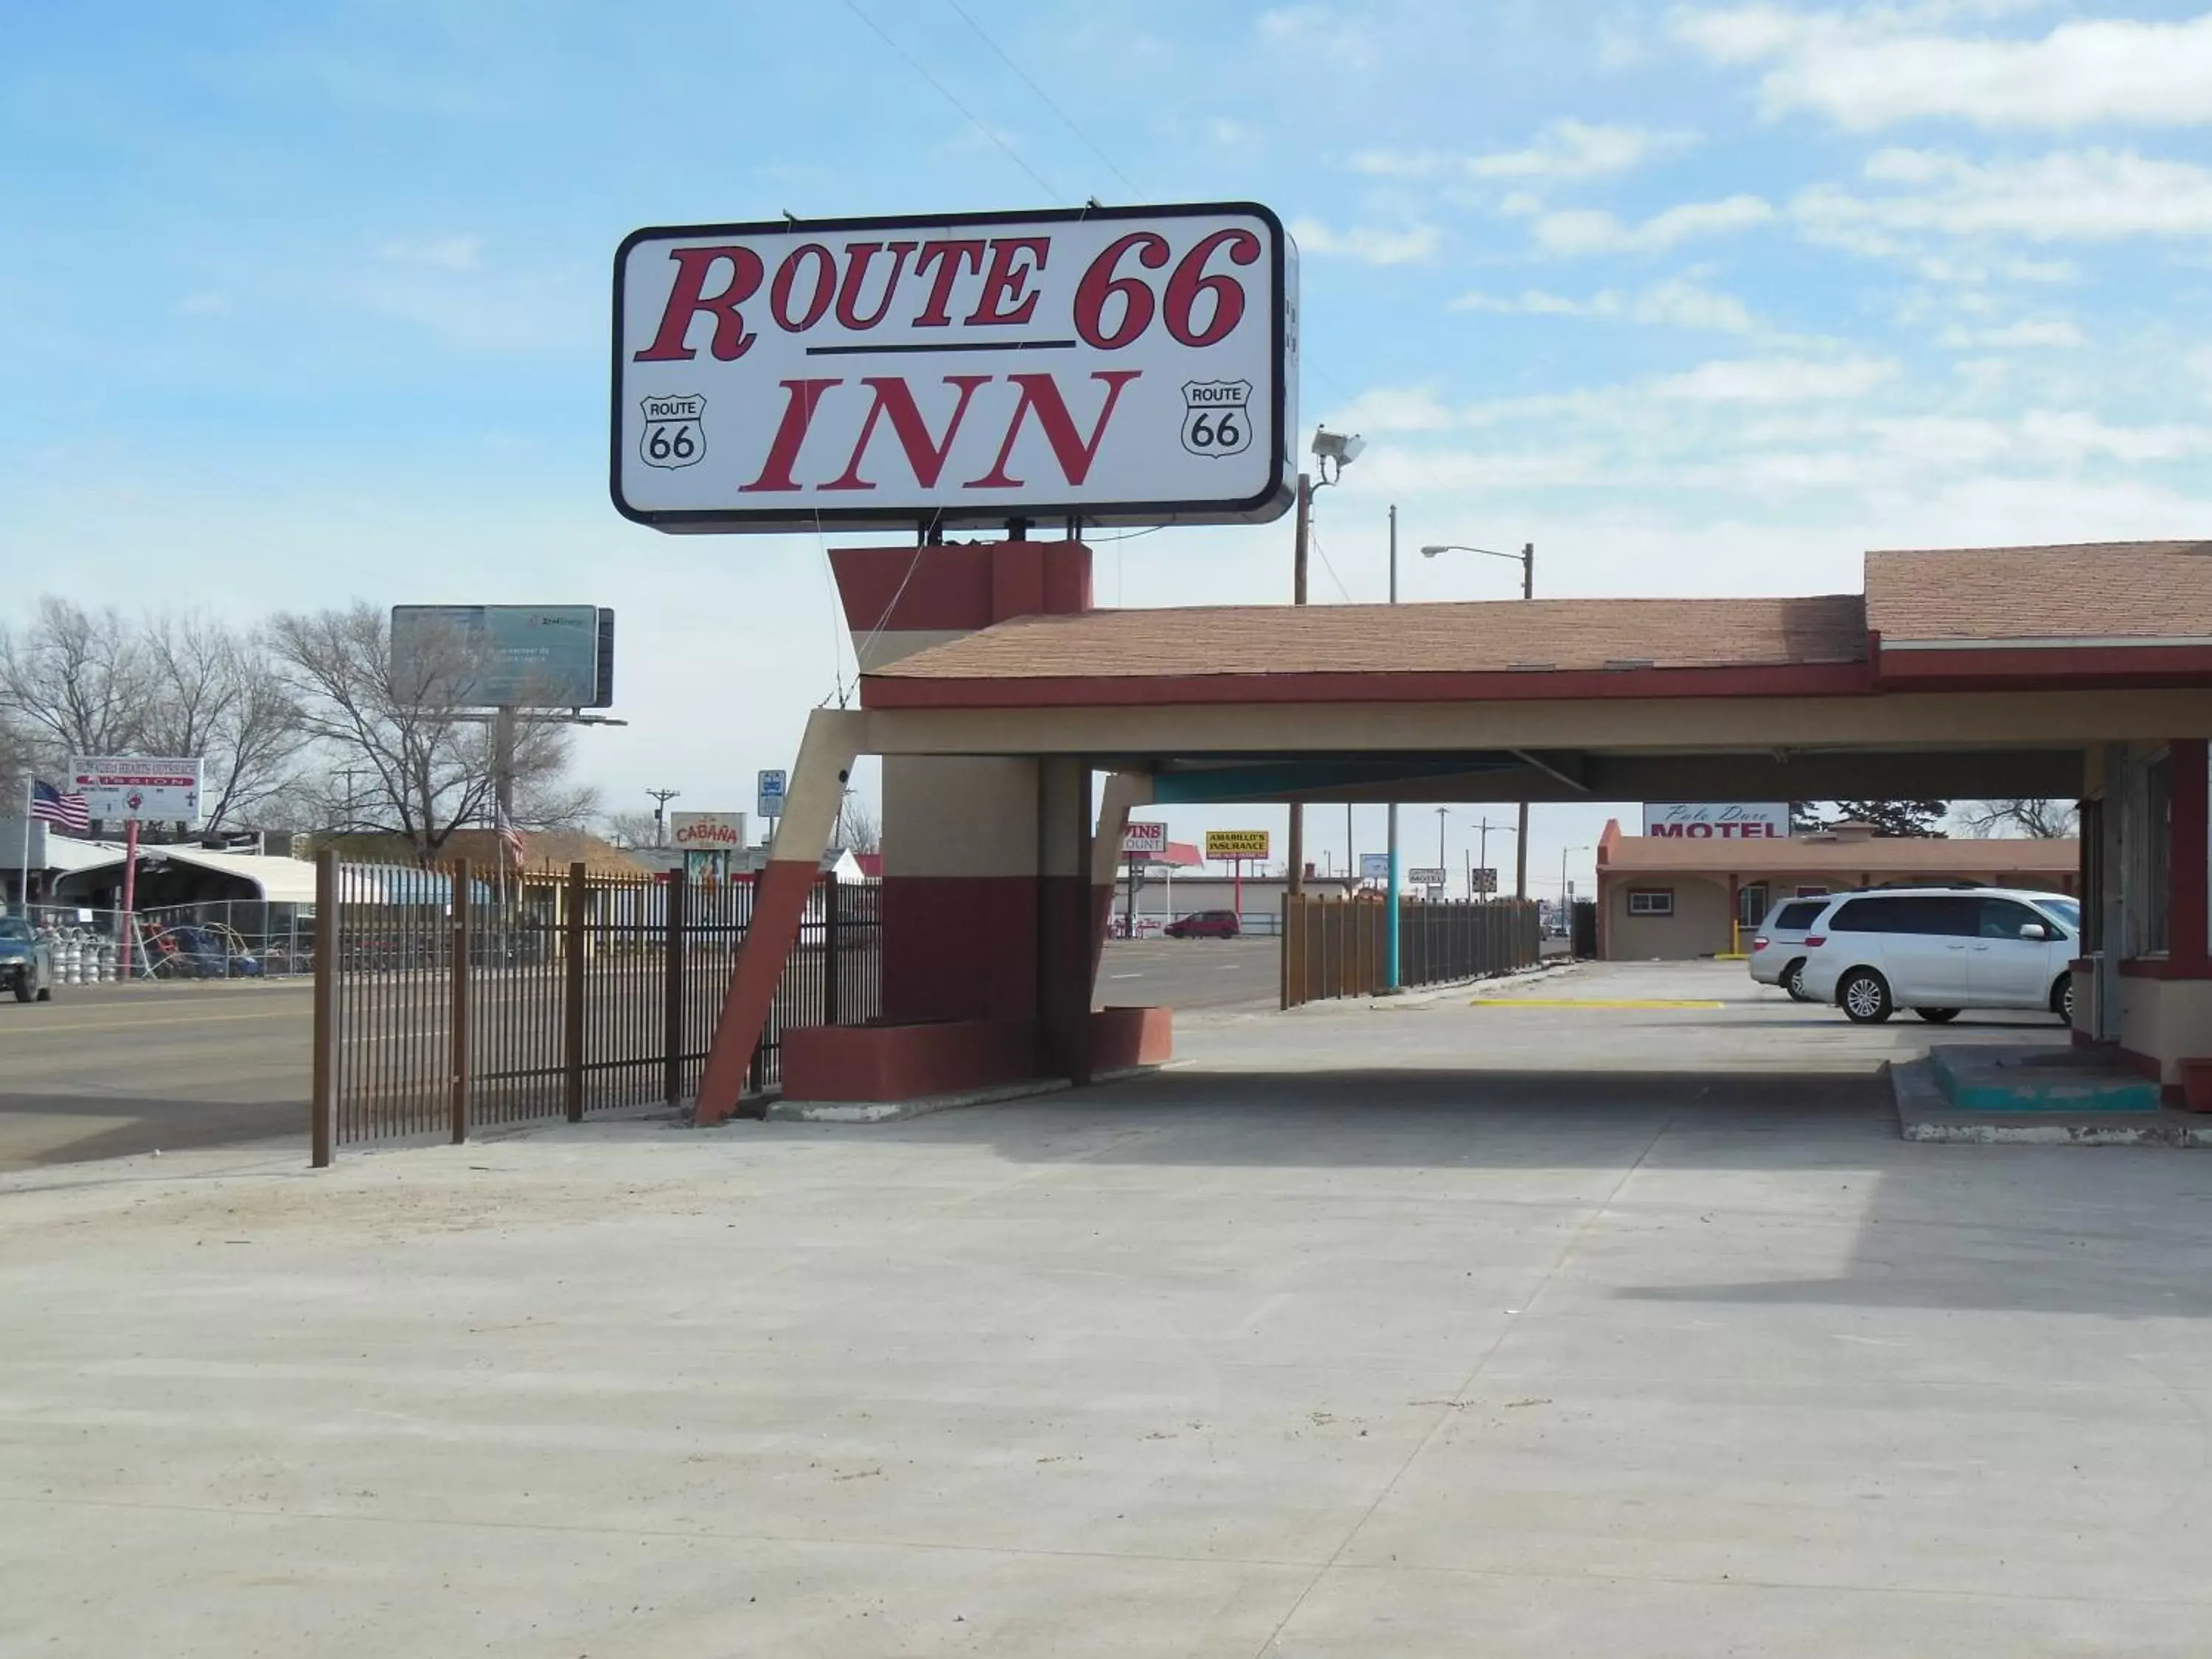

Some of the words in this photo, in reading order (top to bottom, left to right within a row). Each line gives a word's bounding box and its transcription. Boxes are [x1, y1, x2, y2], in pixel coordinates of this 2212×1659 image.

[633, 236, 1051, 362] ROUTE
[1073, 228, 1262, 350] 66
[1192, 388, 1242, 401] ROUTE
[650, 402, 697, 416] ROUTE
[650, 425, 695, 459] 66
[737, 370, 1144, 492] INN
[1191, 412, 1239, 447] 66
[1651, 822, 1784, 838] MOTEL
[1209, 842, 1266, 850] INSURANCE
